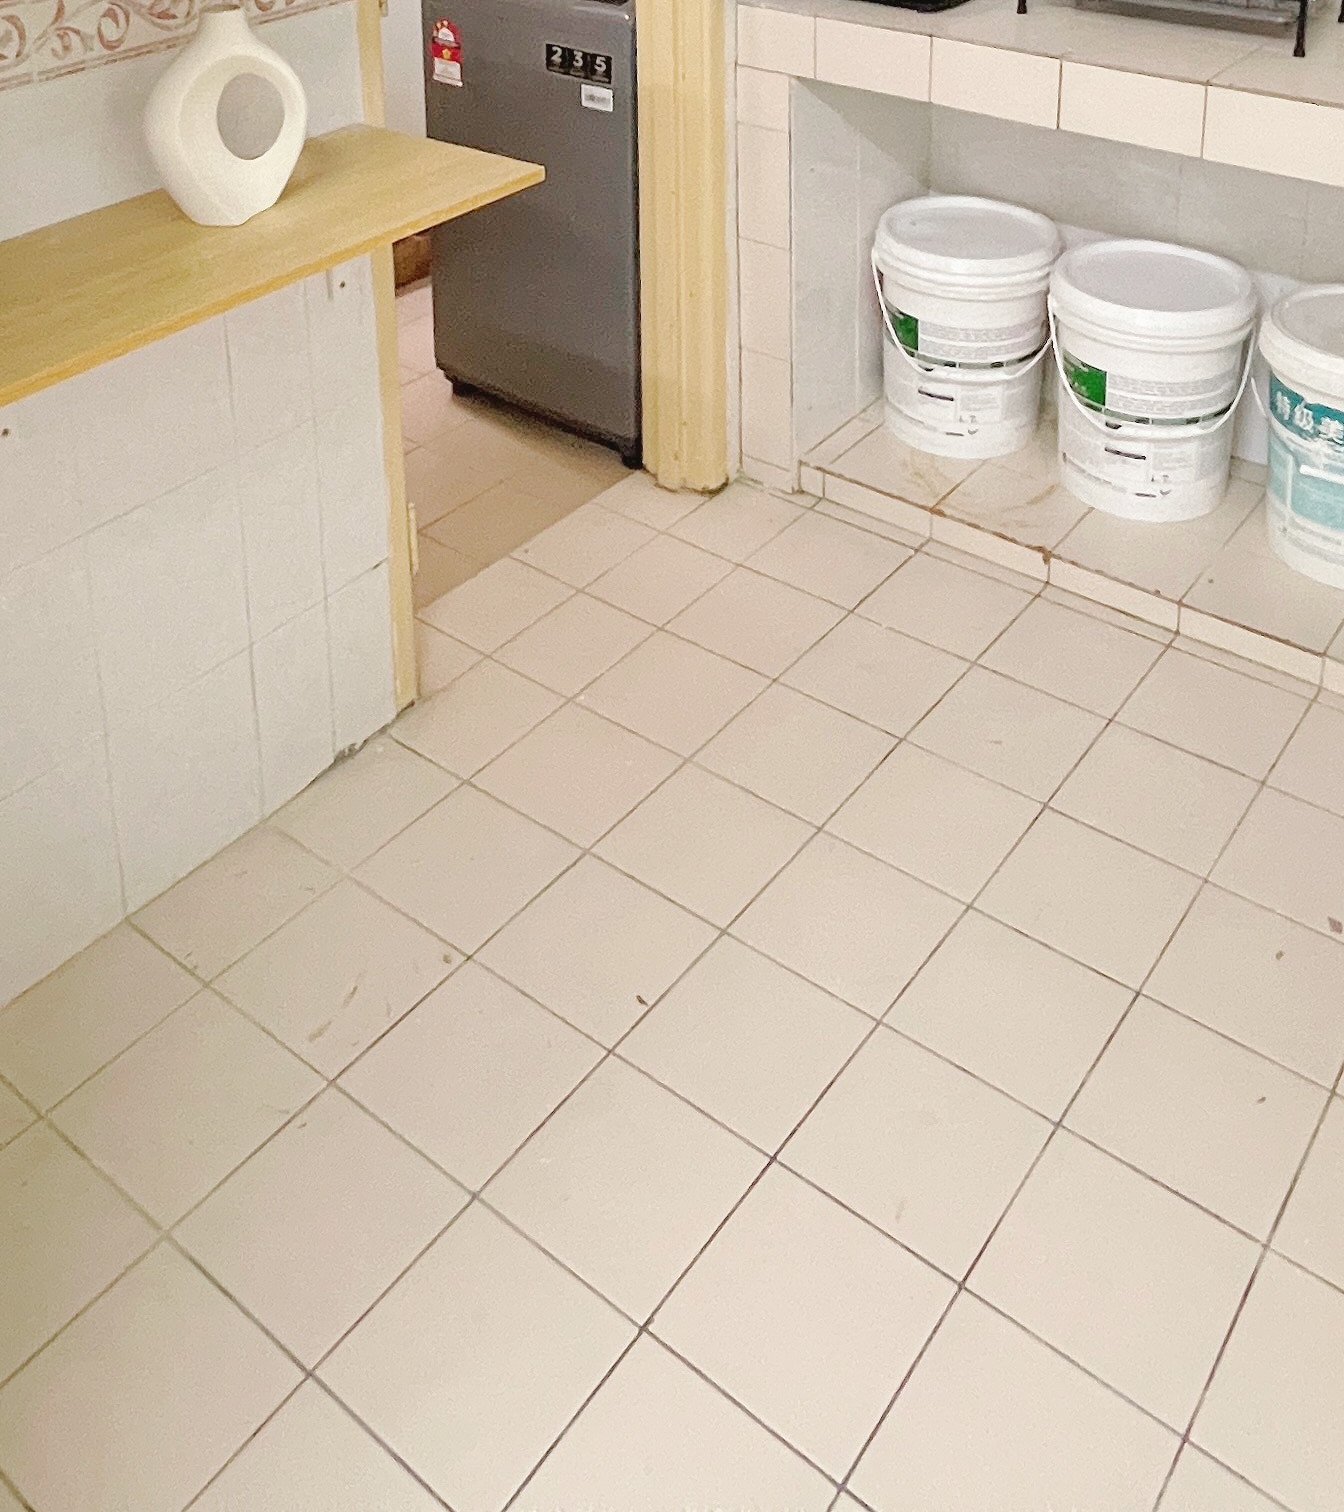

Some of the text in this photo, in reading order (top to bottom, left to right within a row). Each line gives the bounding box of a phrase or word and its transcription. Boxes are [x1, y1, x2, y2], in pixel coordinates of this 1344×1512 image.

[550, 45, 607, 73] 2 3 5
